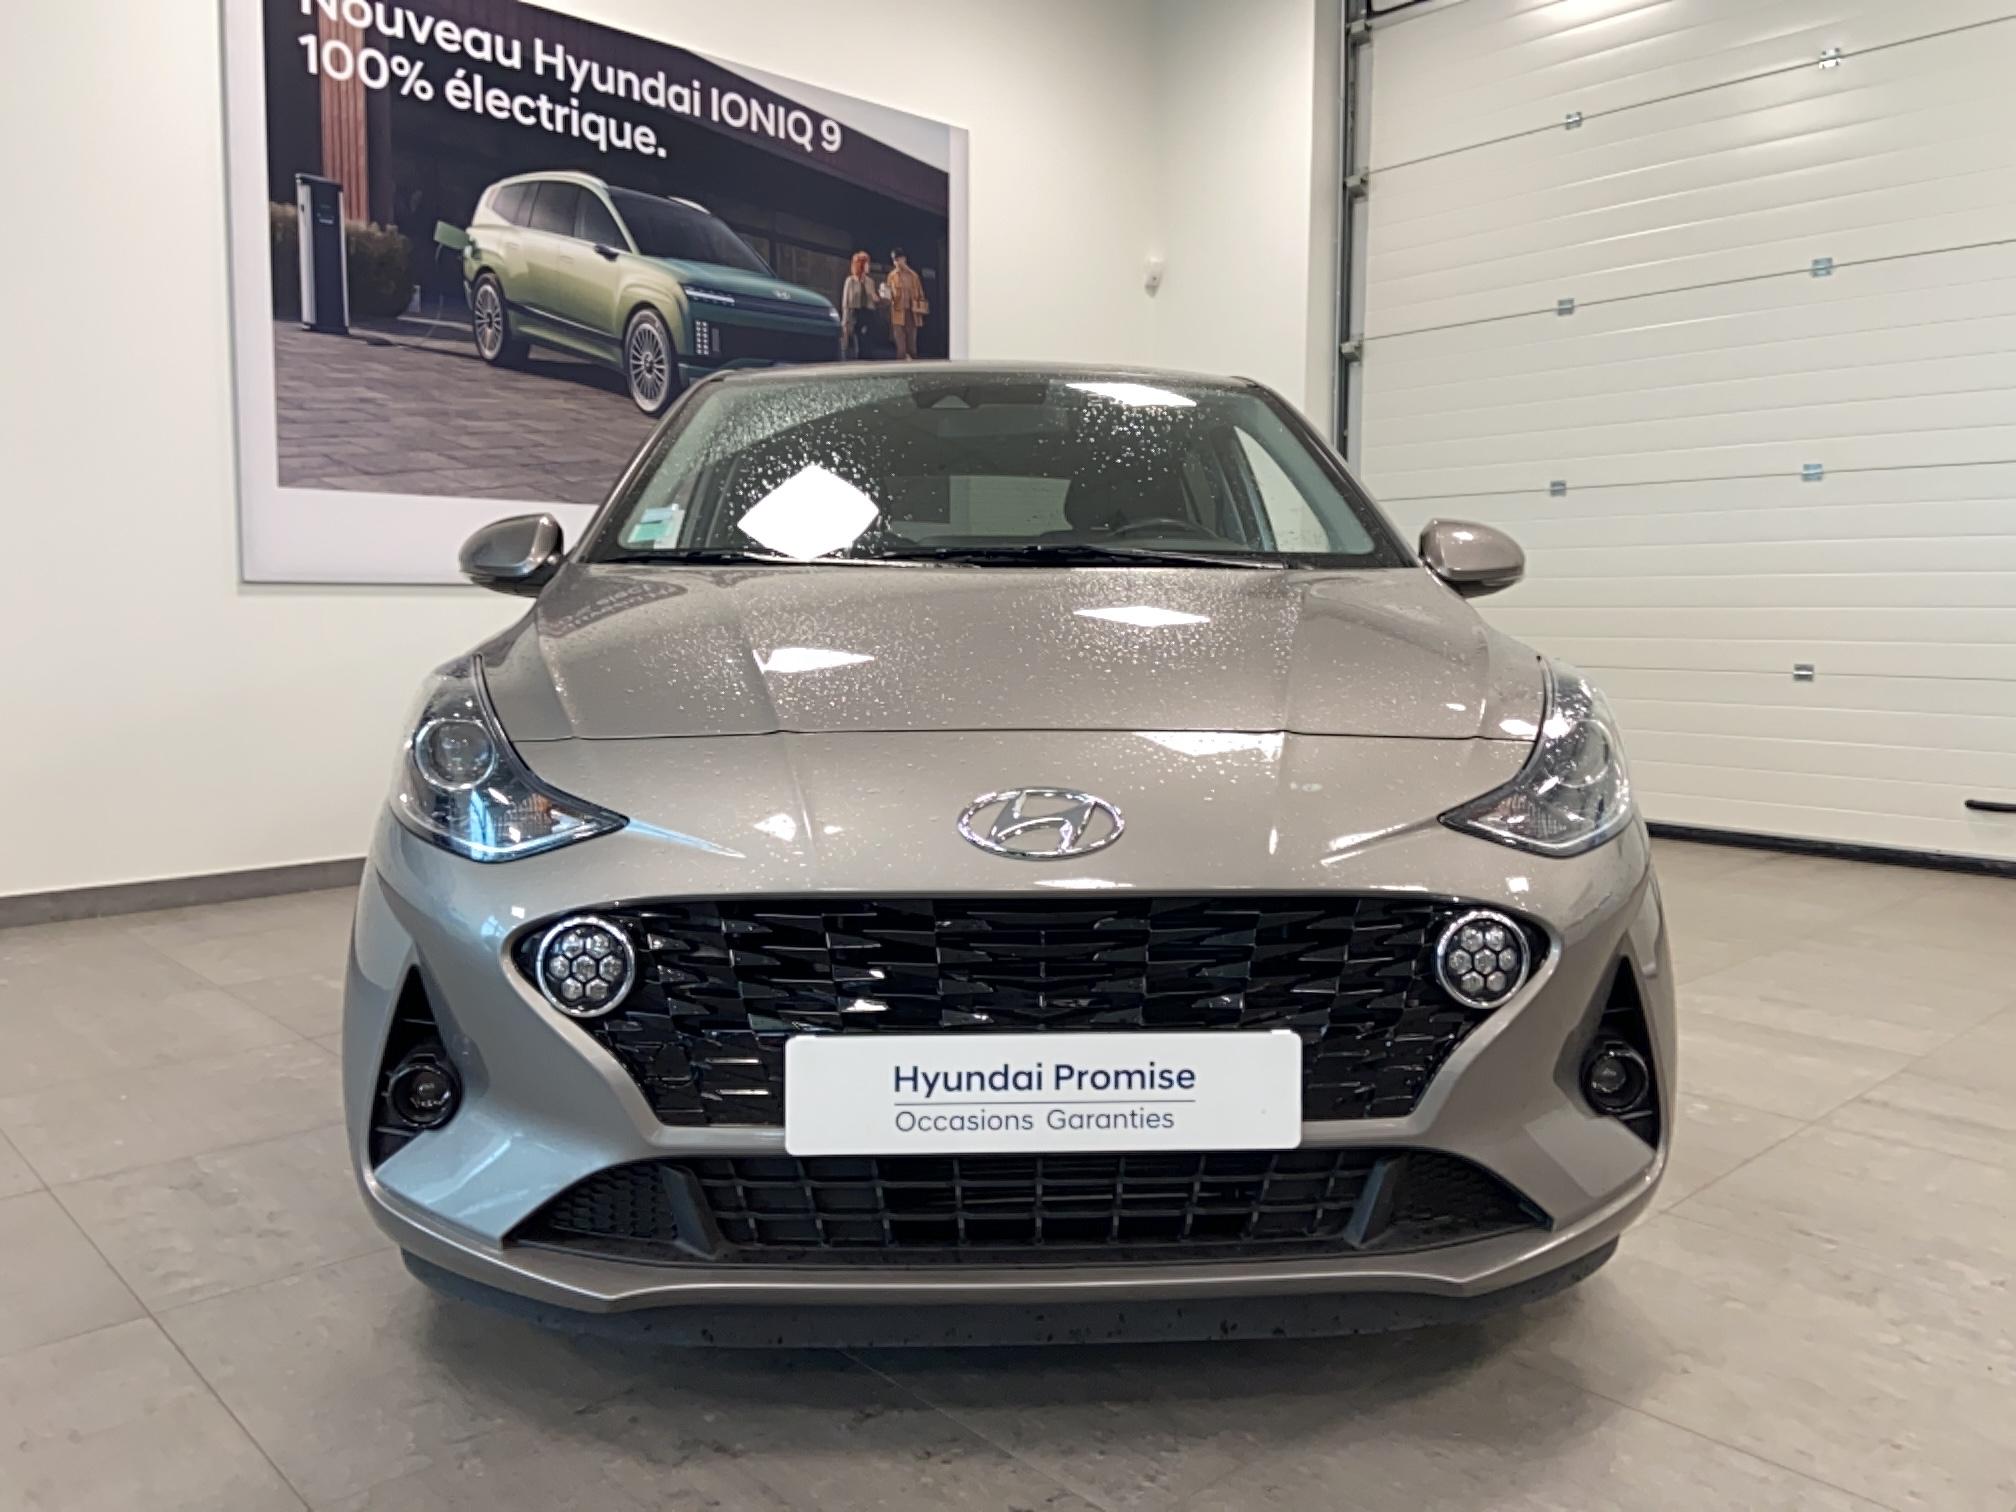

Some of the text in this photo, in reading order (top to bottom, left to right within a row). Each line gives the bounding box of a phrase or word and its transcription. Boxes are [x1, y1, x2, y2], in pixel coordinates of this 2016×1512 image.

[298, 33, 668, 159] 100% électrique.
[533, 37, 702, 118] Hyundai
[711, 87, 814, 153] IONIQ
[820, 119, 843, 152] 9
[893, 1061, 1197, 1098] Hyundai Promise
[895, 1107, 1175, 1132] Occasions Garanties
